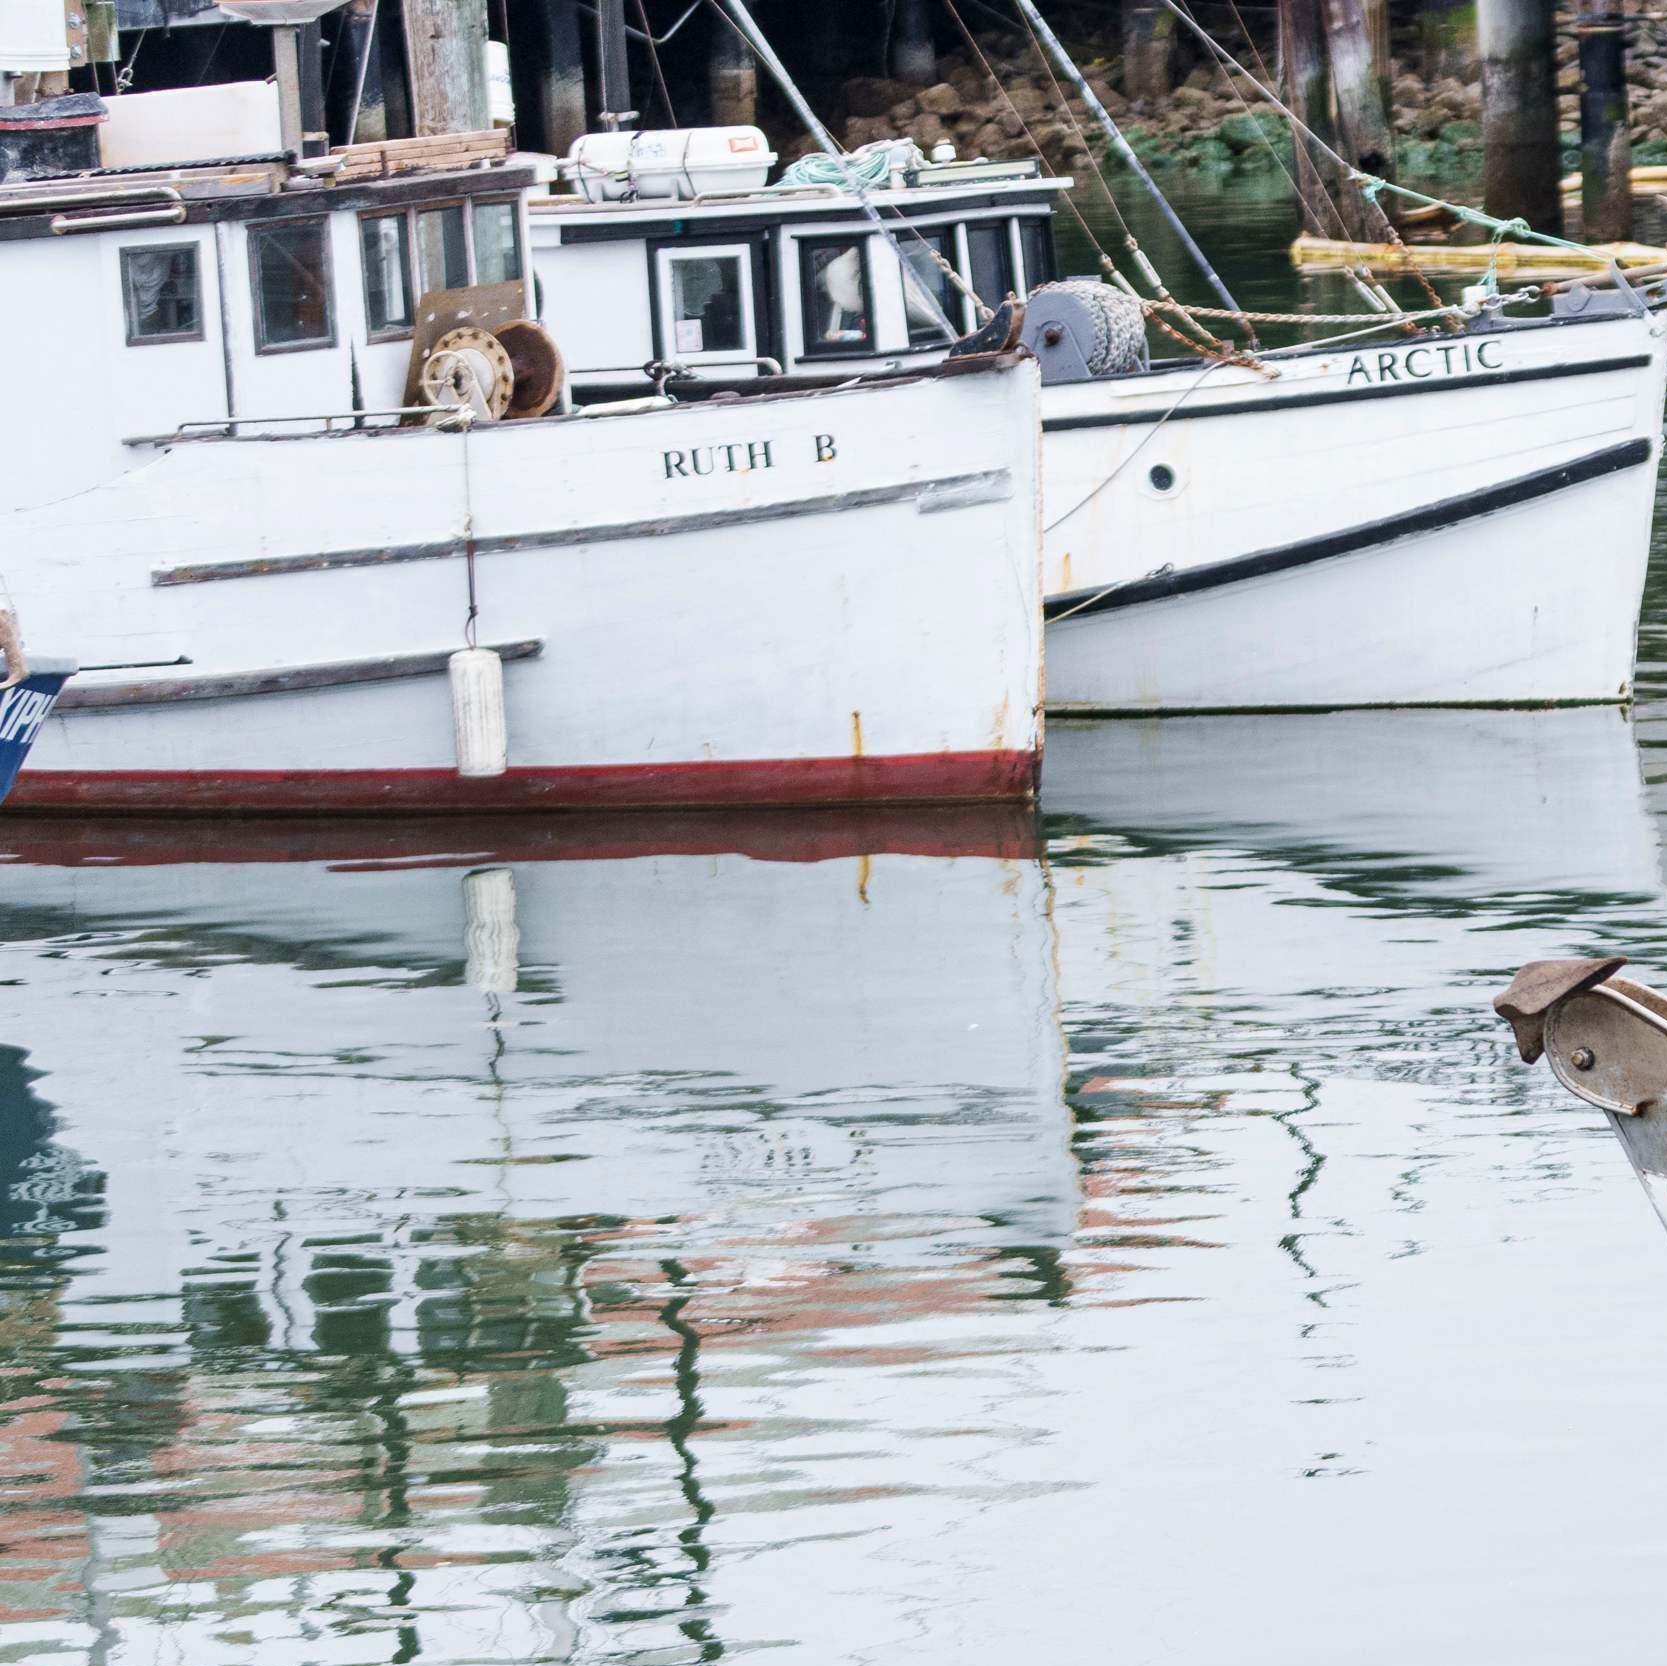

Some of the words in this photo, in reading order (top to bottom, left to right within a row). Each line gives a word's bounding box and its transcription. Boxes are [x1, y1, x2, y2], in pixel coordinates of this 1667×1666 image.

[1347, 340, 1503, 384] ARCTIC
[662, 439, 776, 479] RUTH
[814, 433, 838, 463] B
